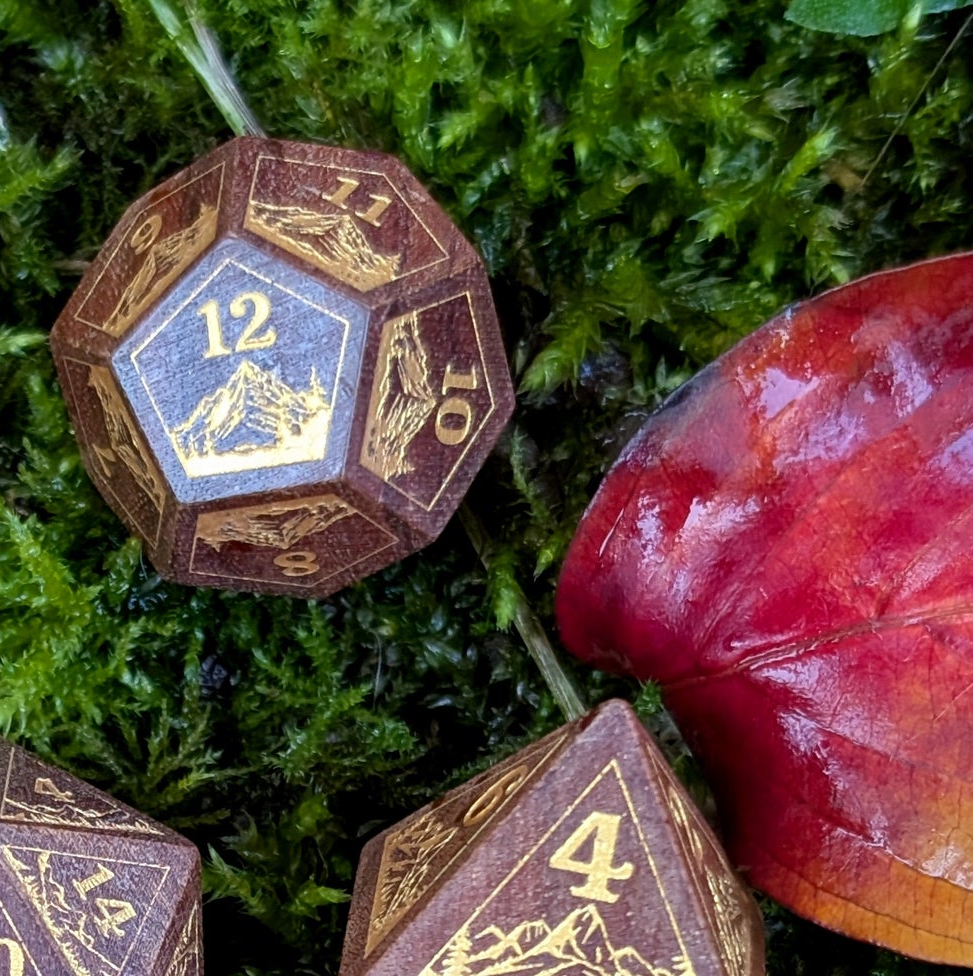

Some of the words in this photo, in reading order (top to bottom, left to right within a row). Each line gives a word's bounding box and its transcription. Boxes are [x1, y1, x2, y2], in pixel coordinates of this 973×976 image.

[322, 176, 392, 227] 11
[197, 292, 276, 358] 12
[434, 364, 478, 446] 10
[273, 550, 320, 576] 8
[34, 777, 76, 803] 4
[549, 810, 634, 905] 4
[73, 862, 136, 937] 14
